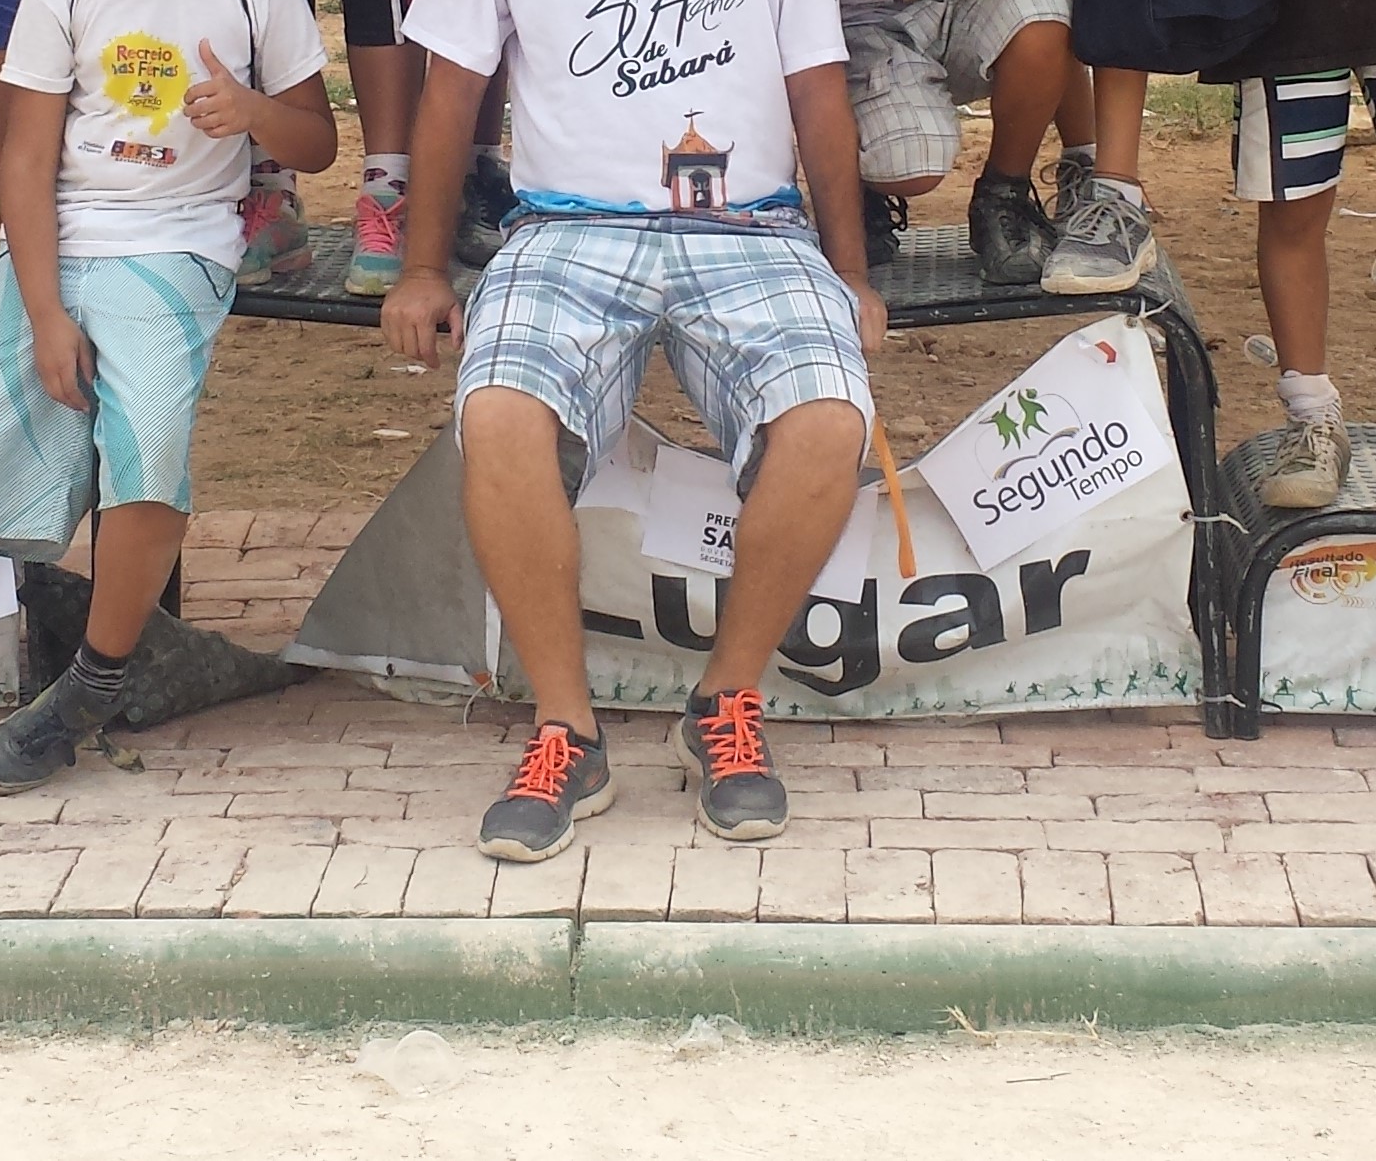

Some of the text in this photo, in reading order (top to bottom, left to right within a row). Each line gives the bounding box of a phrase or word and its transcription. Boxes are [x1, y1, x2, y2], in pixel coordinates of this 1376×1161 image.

[116, 44, 173, 61] Recreio
[643, 41, 669, 64] de
[612, 39, 737, 98] Sabará
[972, 418, 1128, 526] Segundo
[1063, 446, 1143, 503] Tempo
[706, 512, 739, 528] PREF
[702, 526, 733, 551] SA
[1292, 562, 1339, 579] Final
[582, 549, 1091, 696] ugar
